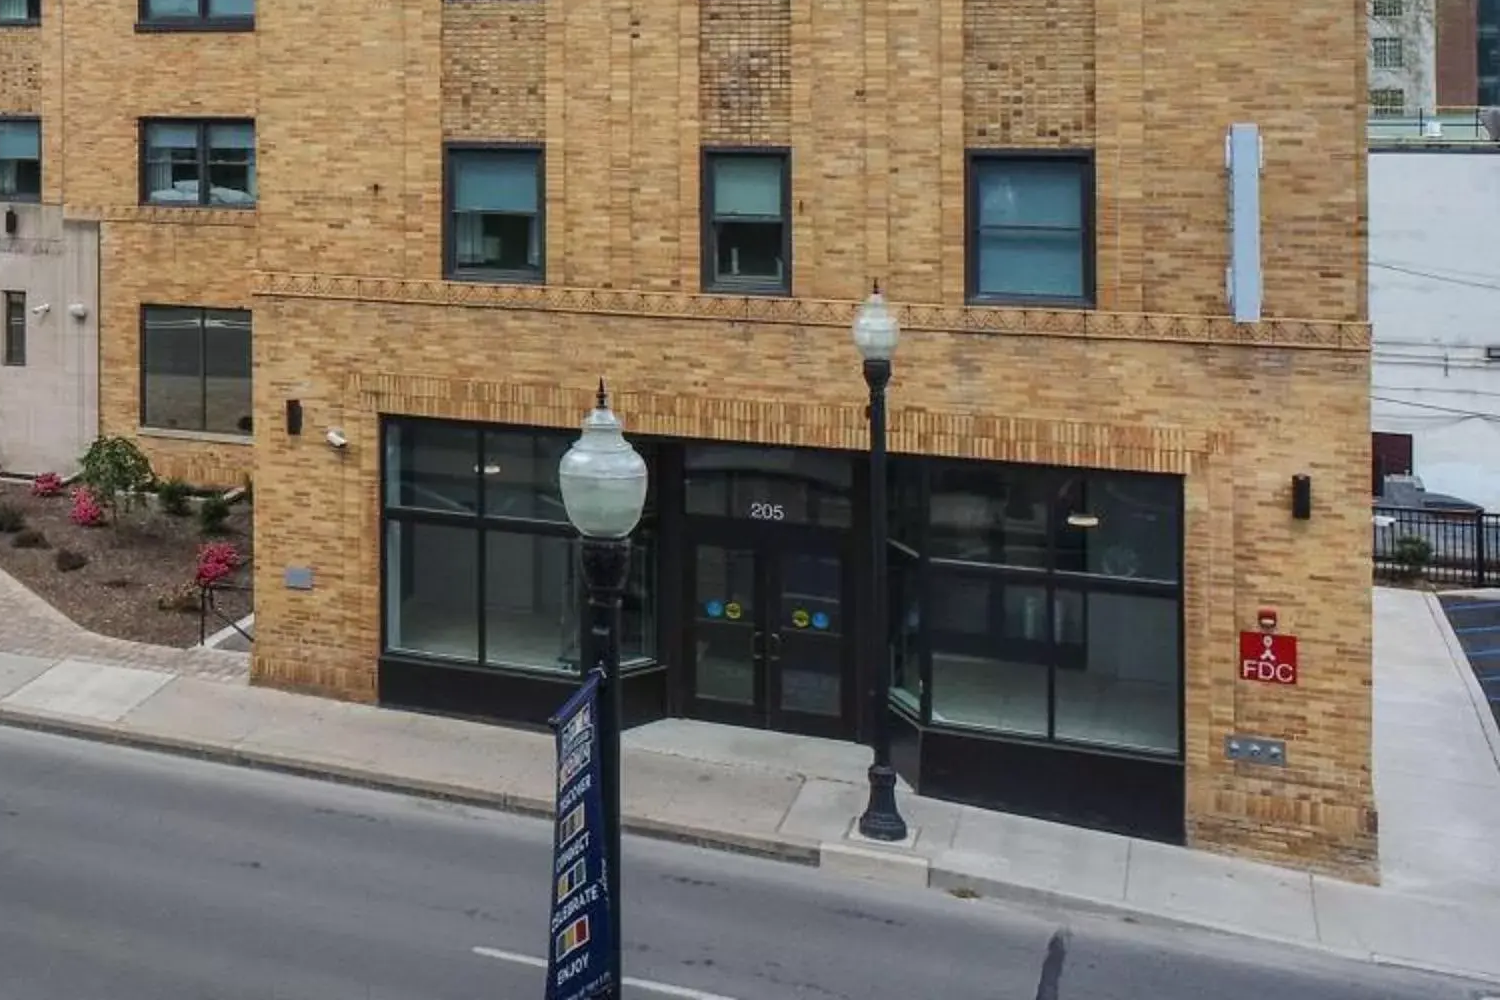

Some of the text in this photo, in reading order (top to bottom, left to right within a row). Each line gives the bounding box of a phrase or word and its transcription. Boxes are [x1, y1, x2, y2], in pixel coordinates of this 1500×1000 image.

[751, 503, 785, 521] 205
[1242, 659, 1295, 683] FDC
[551, 883, 599, 933] CELEBRATE
[556, 952, 589, 985] ENJOY
